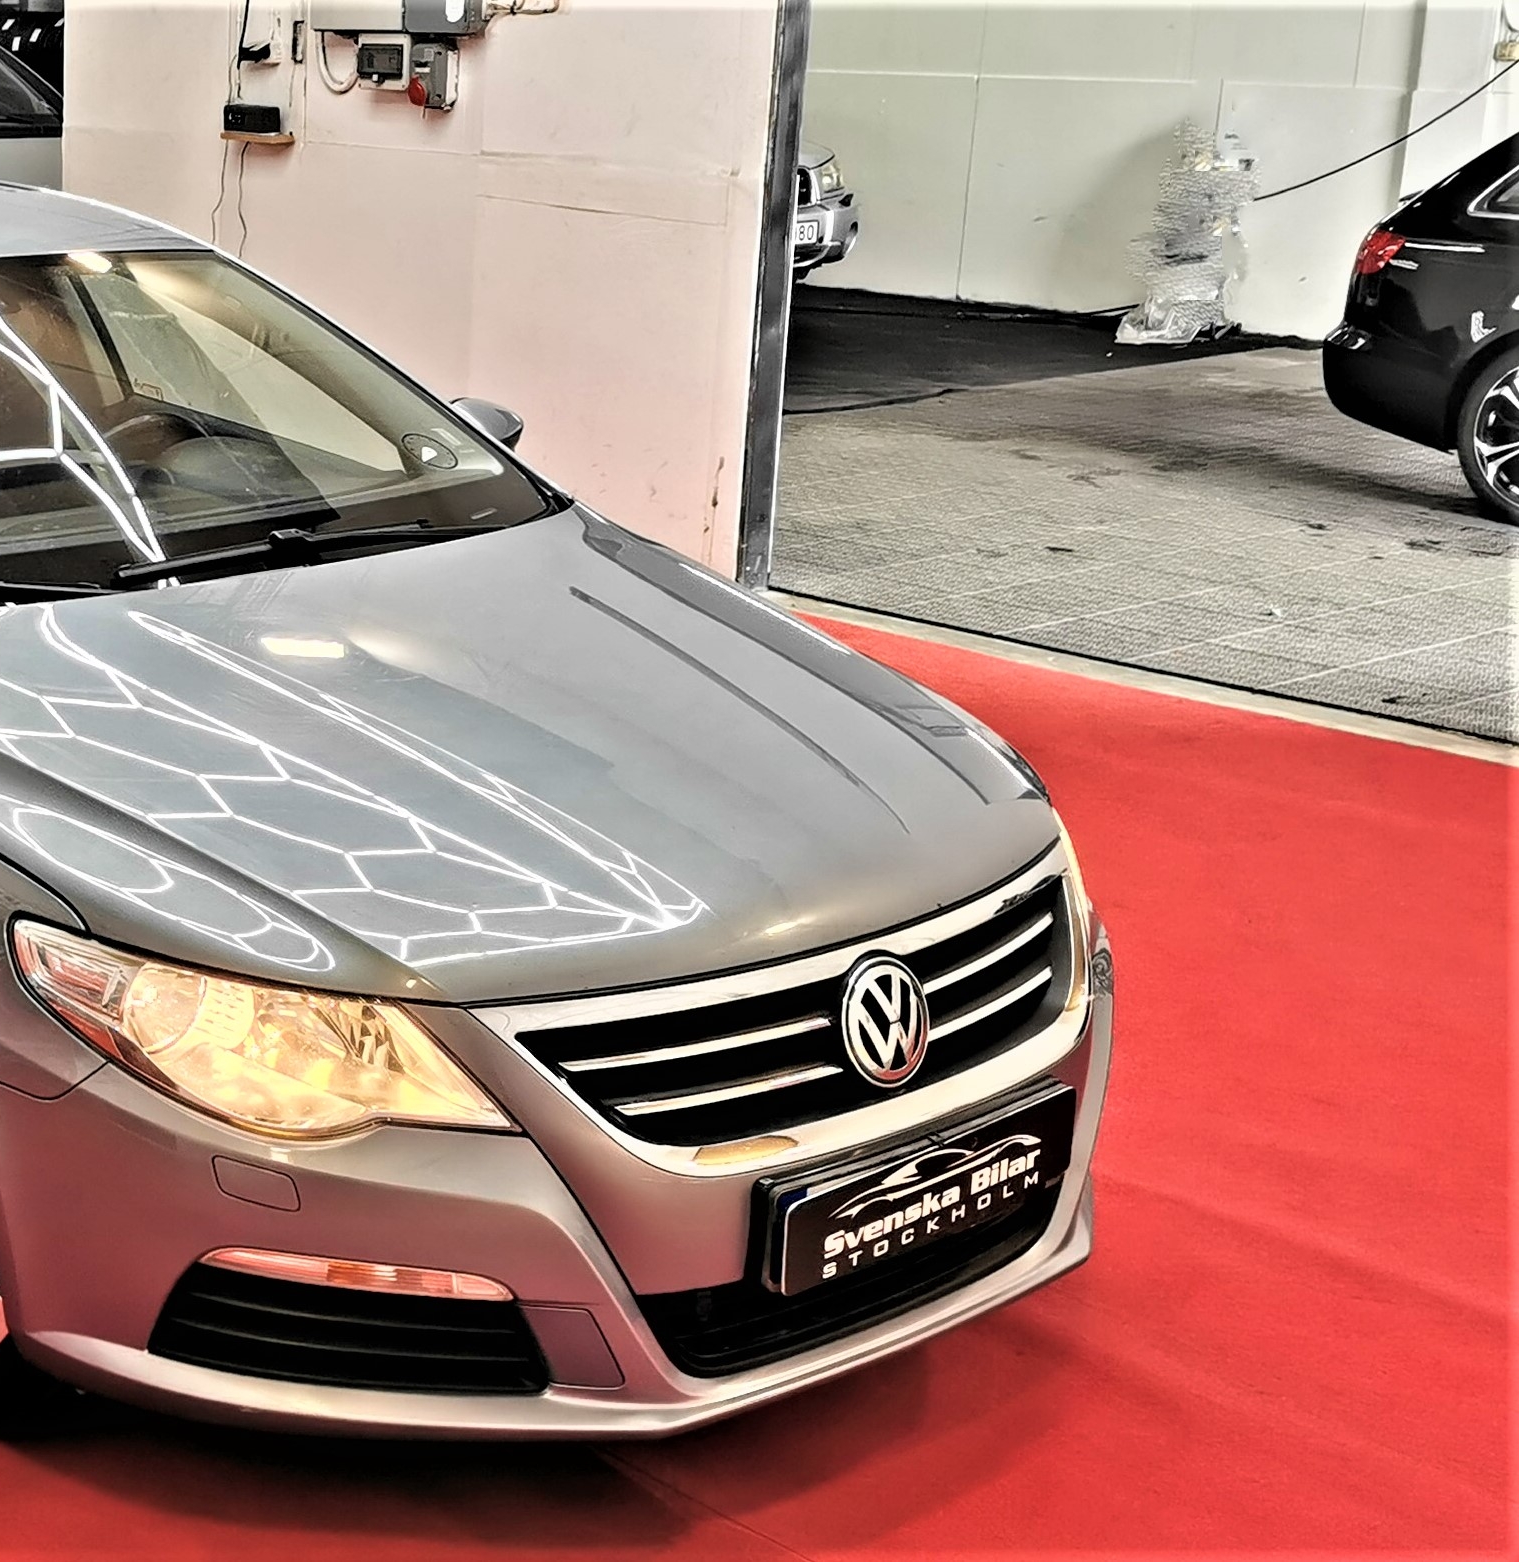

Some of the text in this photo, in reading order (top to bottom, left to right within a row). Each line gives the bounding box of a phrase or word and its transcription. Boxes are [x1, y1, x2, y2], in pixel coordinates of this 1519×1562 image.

[822, 1171, 1039, 1280] STOCKHOLM
[823, 1149, 1041, 1259] Svenska Bilar
